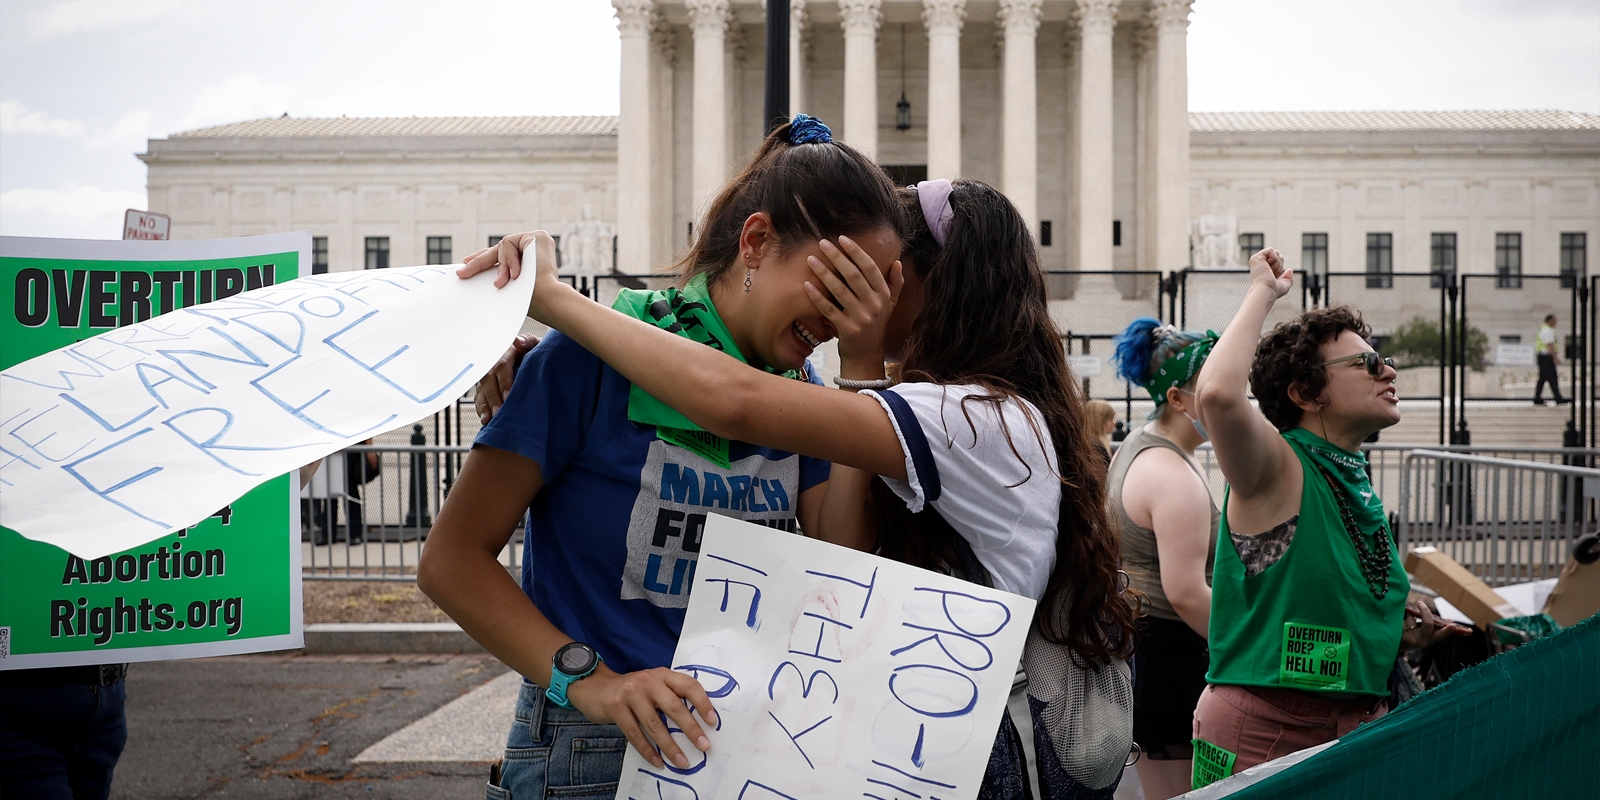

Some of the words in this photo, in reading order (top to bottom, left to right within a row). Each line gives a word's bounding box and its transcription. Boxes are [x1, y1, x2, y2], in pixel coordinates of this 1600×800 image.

[139, 216, 156, 230] NO
[58, 310, 306, 432] LAND
[298, 280, 369, 319] OF
[60, 309, 475, 529] FREE
[660, 463, 789, 513] MARCH
[652, 508, 707, 553] FO
[61, 541, 225, 585] Abortion
[705, 554, 768, 633] IF
[51, 596, 243, 645] Rights.org
[1288, 626, 1342, 645] OVERTURN
[768, 566, 878, 769] THEY
[1285, 656, 1315, 674] HELL
[1320, 660, 1342, 677] NO!
[1287, 640, 1315, 655] ROE?
[863, 587, 1012, 800] PRO-li
[1197, 741, 1229, 767] FORCED
